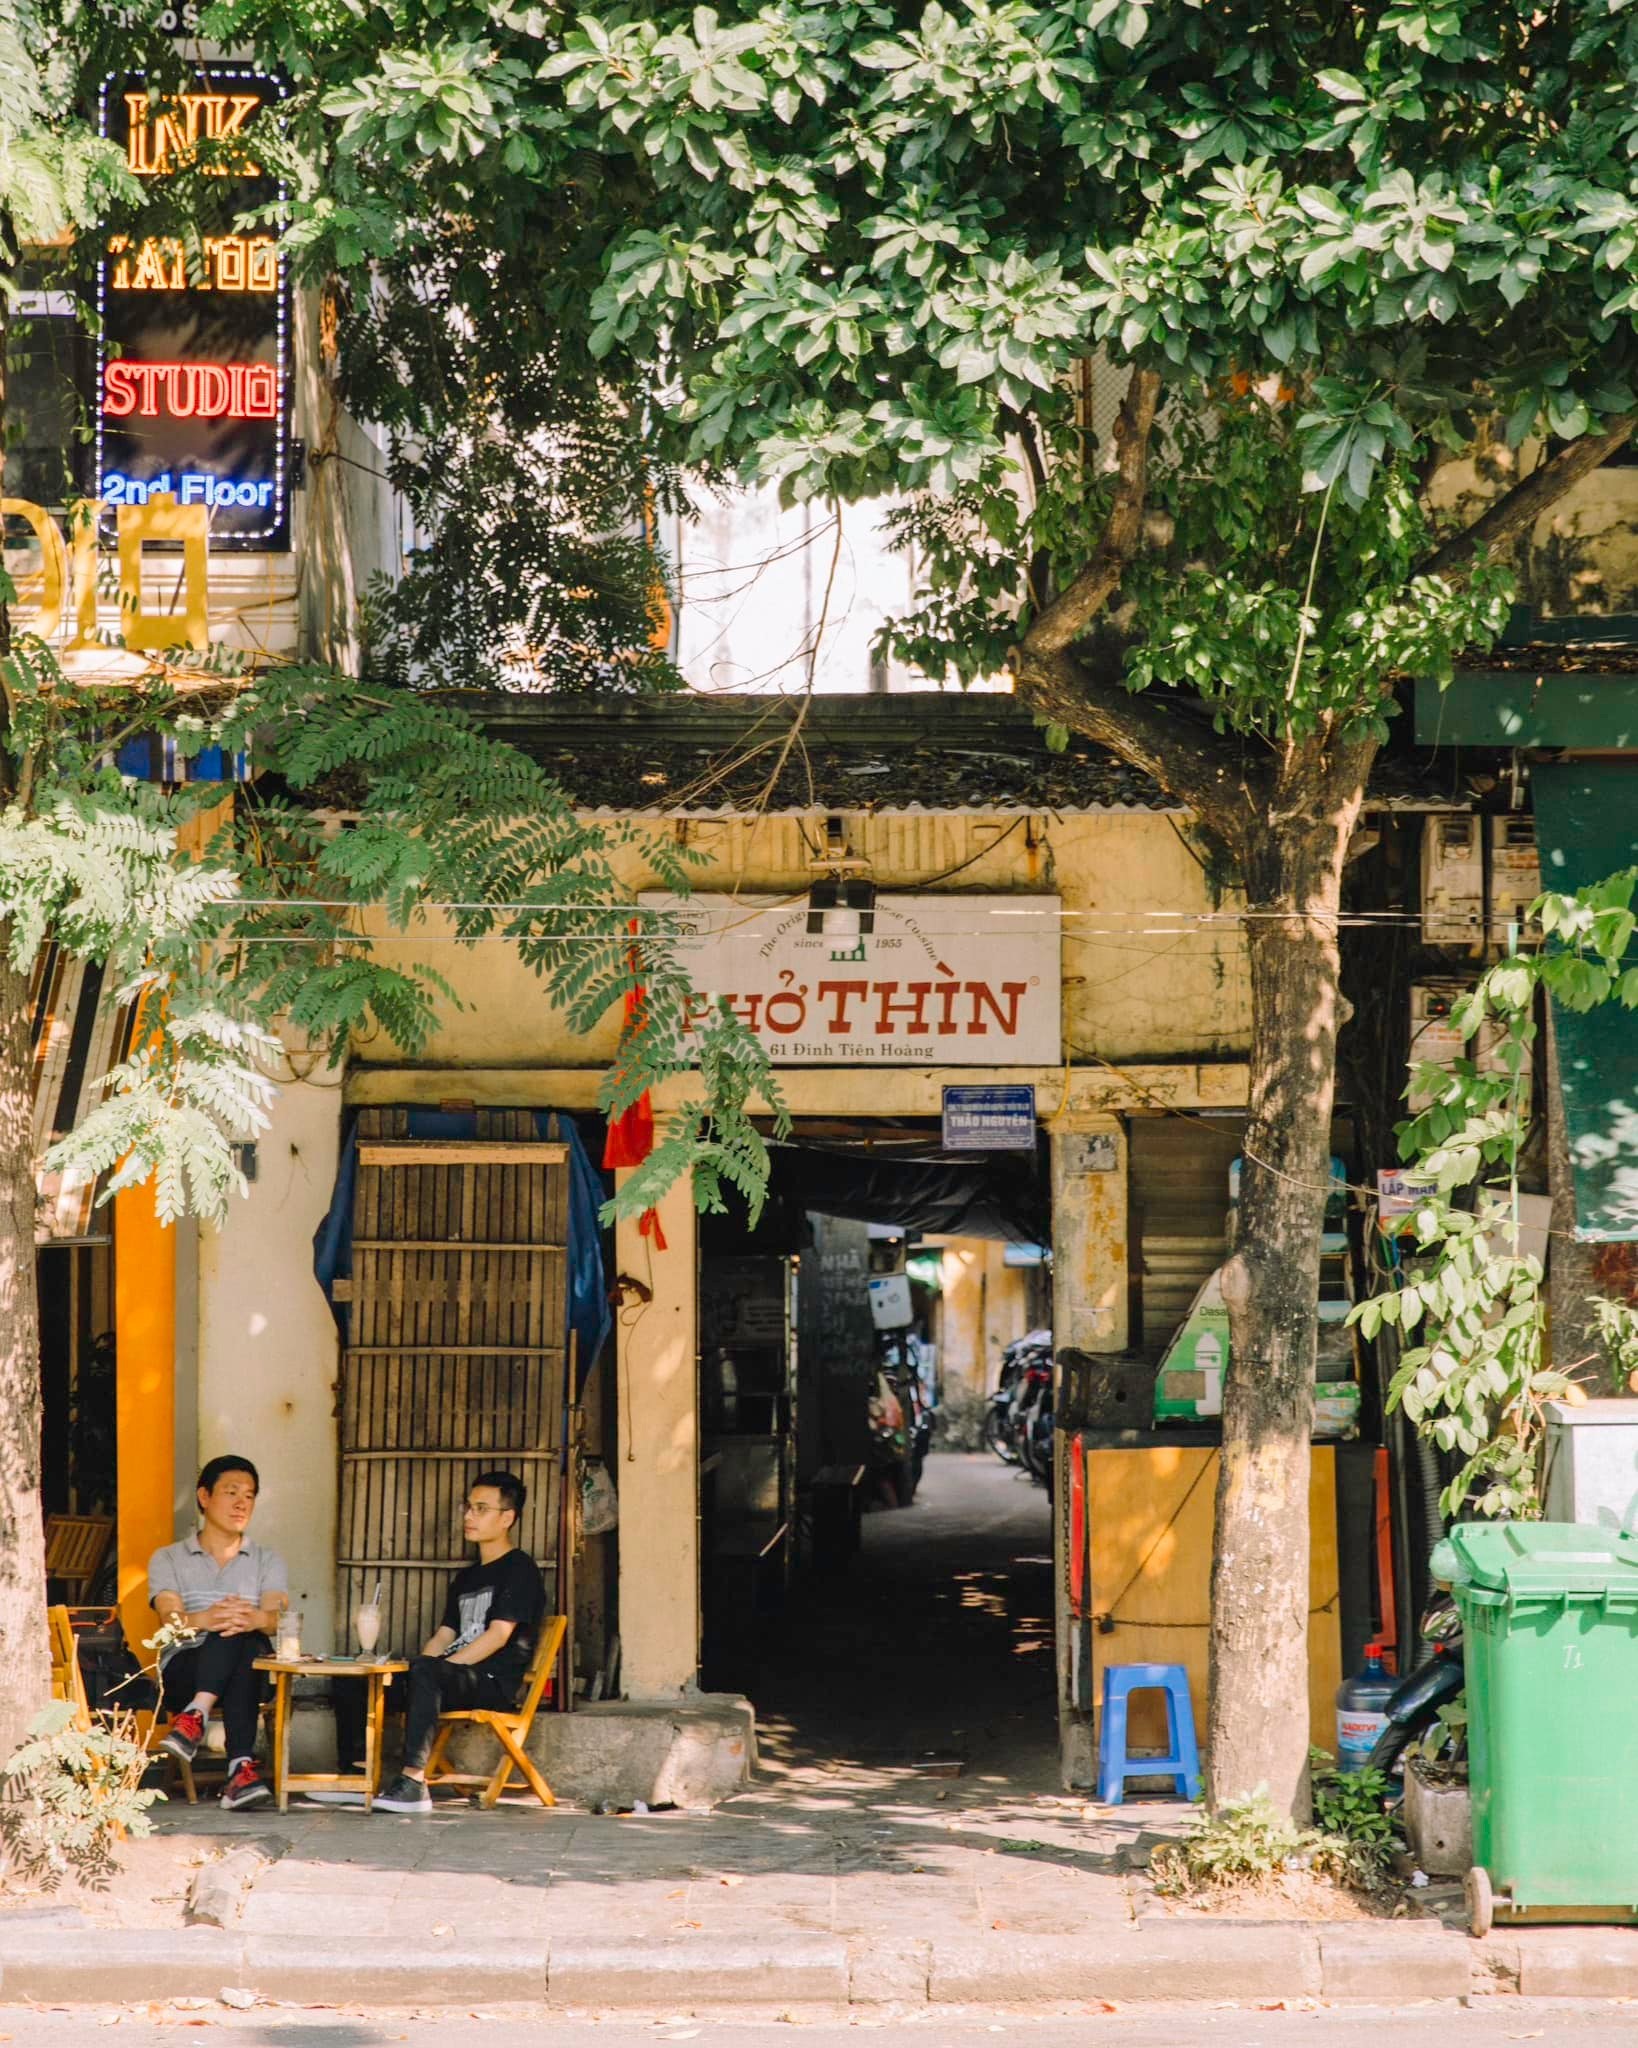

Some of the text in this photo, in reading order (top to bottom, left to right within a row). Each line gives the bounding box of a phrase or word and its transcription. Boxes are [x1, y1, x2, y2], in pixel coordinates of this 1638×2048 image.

[124, 94, 260, 176] INK
[103, 360, 277, 418] STUDIO
[102, 473, 274, 507] 2nd Floor
[759, 937, 777, 958] The
[876, 938, 903, 949] 1955
[679, 961, 1028, 1036] PHỞ THÌN
[770, 1042, 786, 1057] 61
[838, 1042, 875, 1057] Tiên
[880, 1042, 934, 1060] Hoàng
